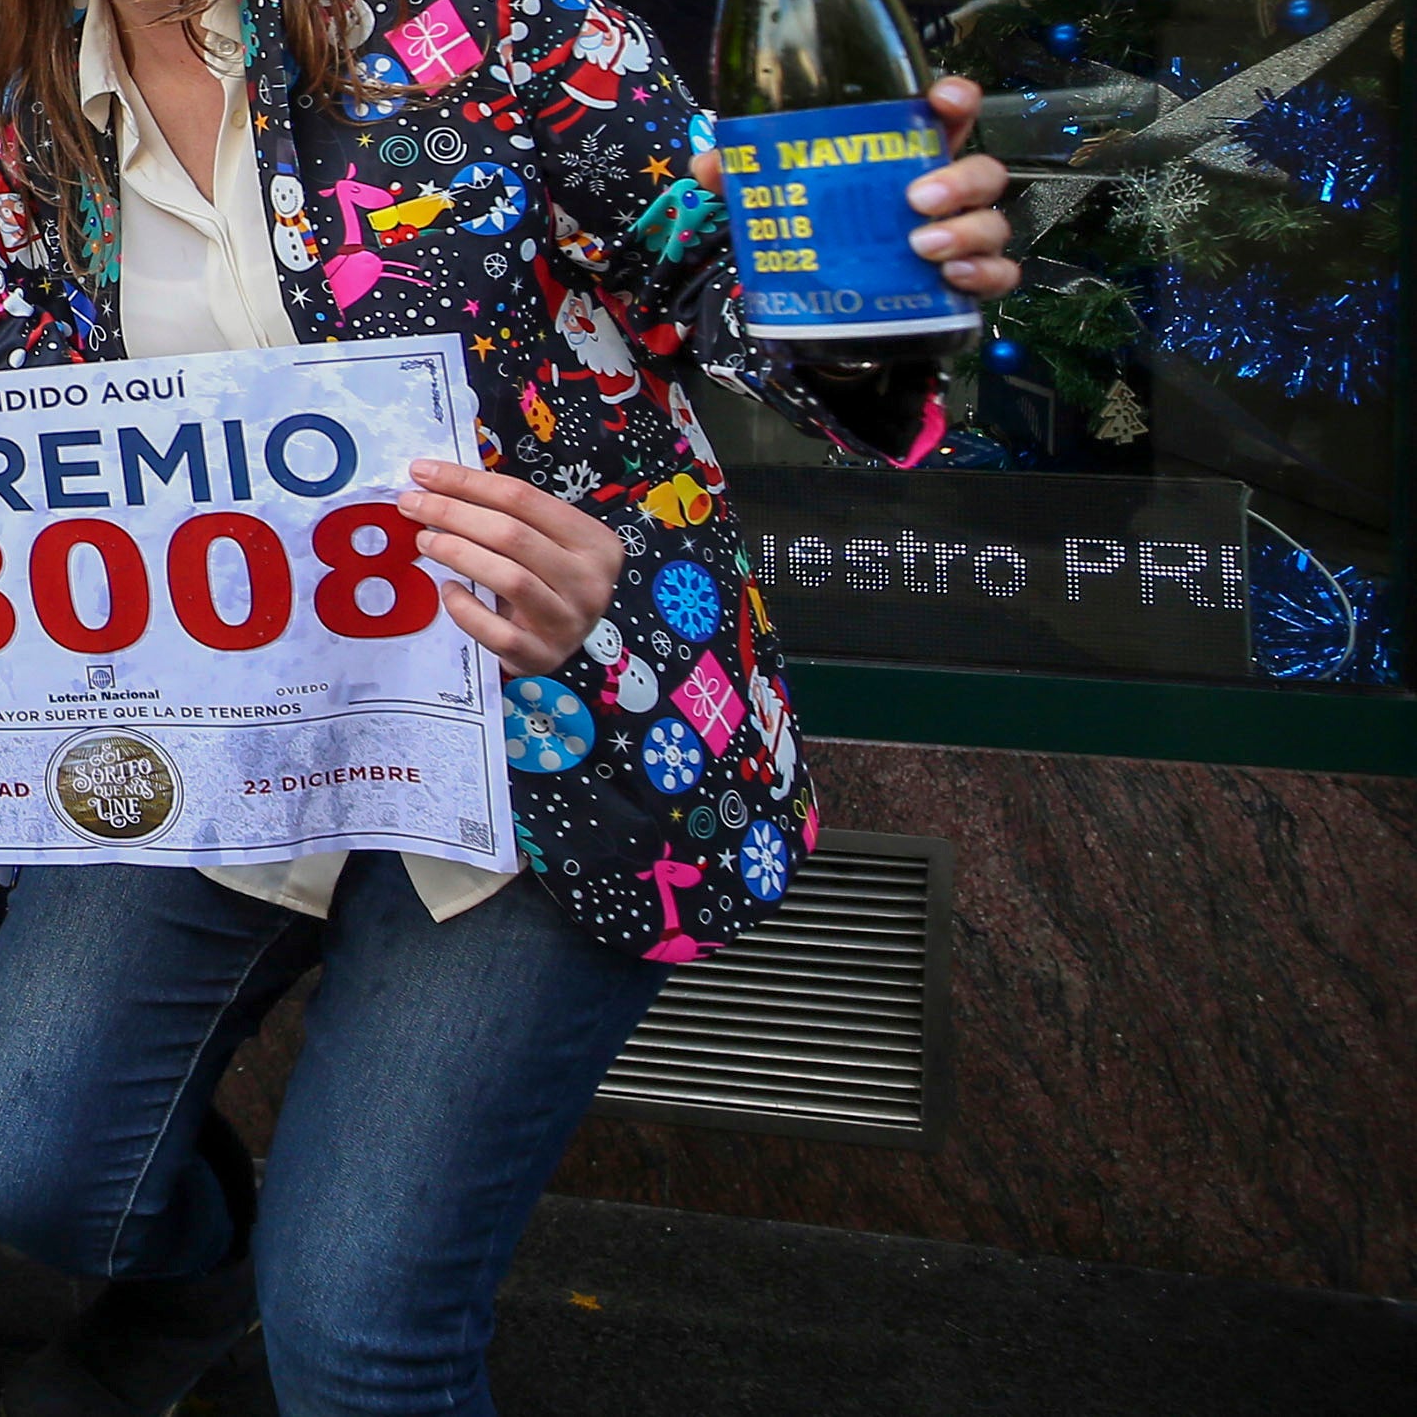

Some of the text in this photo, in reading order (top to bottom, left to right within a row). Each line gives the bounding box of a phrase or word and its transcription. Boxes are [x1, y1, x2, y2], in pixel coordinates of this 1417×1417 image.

[741, 182, 808, 209] 2012
[746, 215, 813, 241] 2018
[753, 248, 820, 273] 2022
[100, 368, 187, 406] AQUÍ
[100, 687, 160, 701] Nacional
[276, 682, 330, 698] OVIEDO
[45, 707, 108, 721] SUERTE
[113, 706, 150, 720] QUE
[153, 706, 177, 718] LA
[181, 706, 205, 719] DE
[207, 702, 303, 720] TENERNOS
[244, 763, 423, 796] 22 DICIEMBRE
